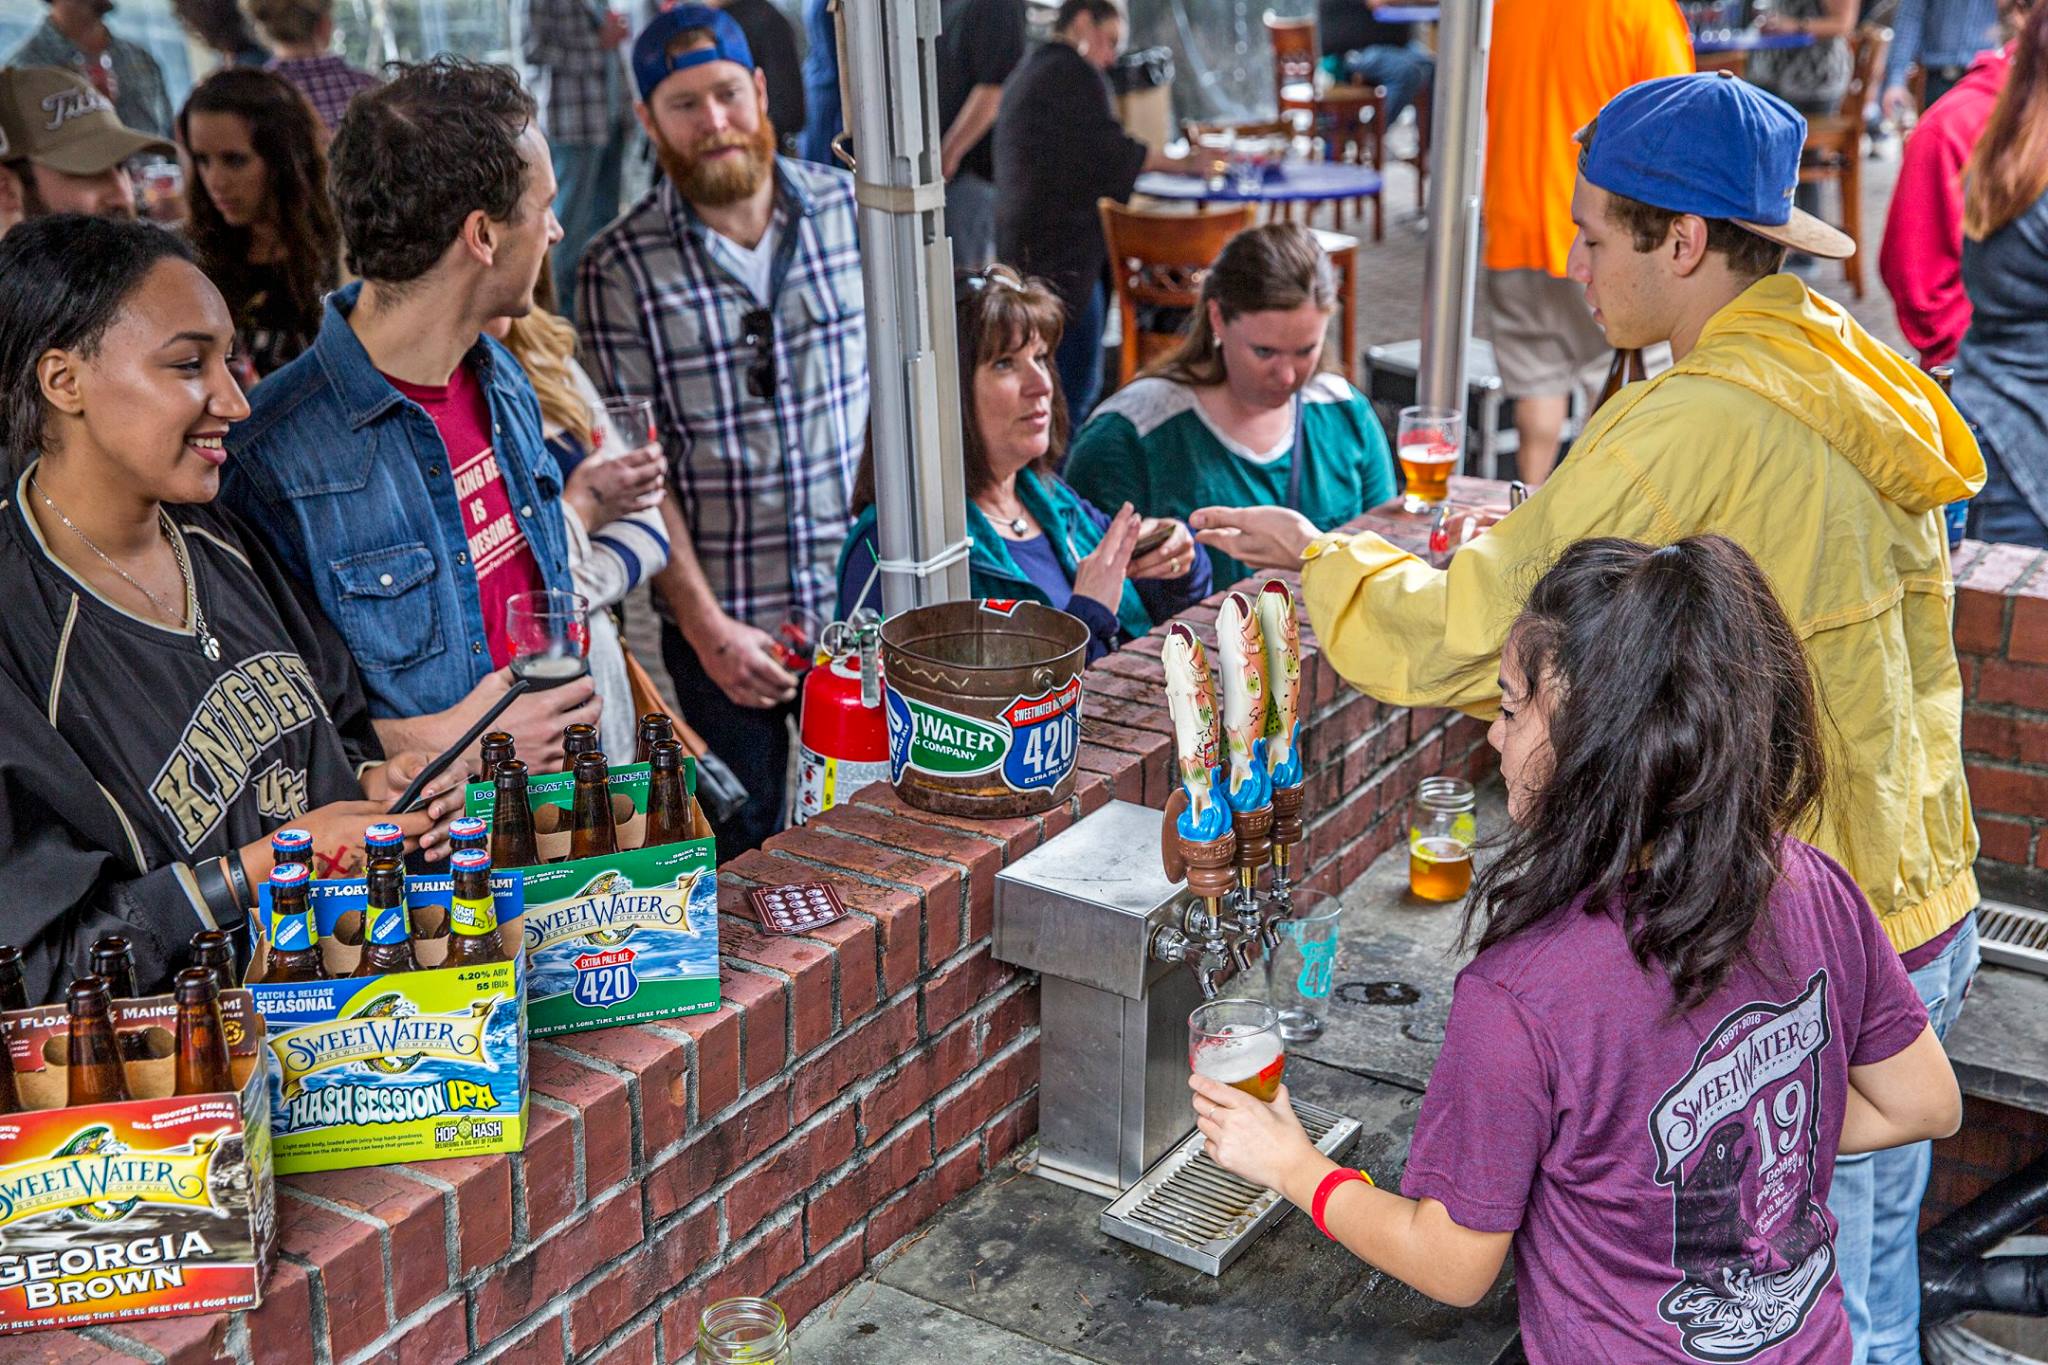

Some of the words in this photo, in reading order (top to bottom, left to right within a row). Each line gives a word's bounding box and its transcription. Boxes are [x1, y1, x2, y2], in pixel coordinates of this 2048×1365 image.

[470, 498, 487, 524] IS
[468, 513, 516, 562] WESOME
[912, 711, 995, 752] TWATER
[1023, 713, 1072, 774] 420
[922, 740, 977, 761] COMPANY
[252, 759, 307, 820] UCF
[527, 782, 562, 794] LOAT
[1024, 774, 1047, 784] EXTRA
[1048, 766, 1062, 776] PALE
[458, 971, 491, 982] 4.20%
[492, 968, 508, 977] ABV
[581, 956, 601, 968] EXTRA
[602, 954, 617, 966] PALE
[618, 952, 630, 962] ALE
[256, 990, 286, 1000] CATCH
[287, 989, 296, 999] &
[298, 988, 334, 998] RELEASE
[476, 982, 490, 991] 55
[581, 966, 631, 1003] 420
[256, 997, 336, 1014] SEASONAL
[286, 1018, 479, 1072] SWEETWATER
[1667, 1020, 1821, 1151] SWEETWATER
[289, 1084, 352, 1133] HASH
[350, 1080, 447, 1126] SESSION
[446, 1079, 501, 1111] IPA
[435, 1126, 458, 1142] HOP
[471, 1120, 503, 1138] HASH
[1753, 1080, 1806, 1177] 19
[0, 1230, 213, 1287] GEORGIA
[24, 1265, 185, 1309] BROWN
[67, 1315, 91, 1323] LONG
[202, 1297, 226, 1307] GOOD
